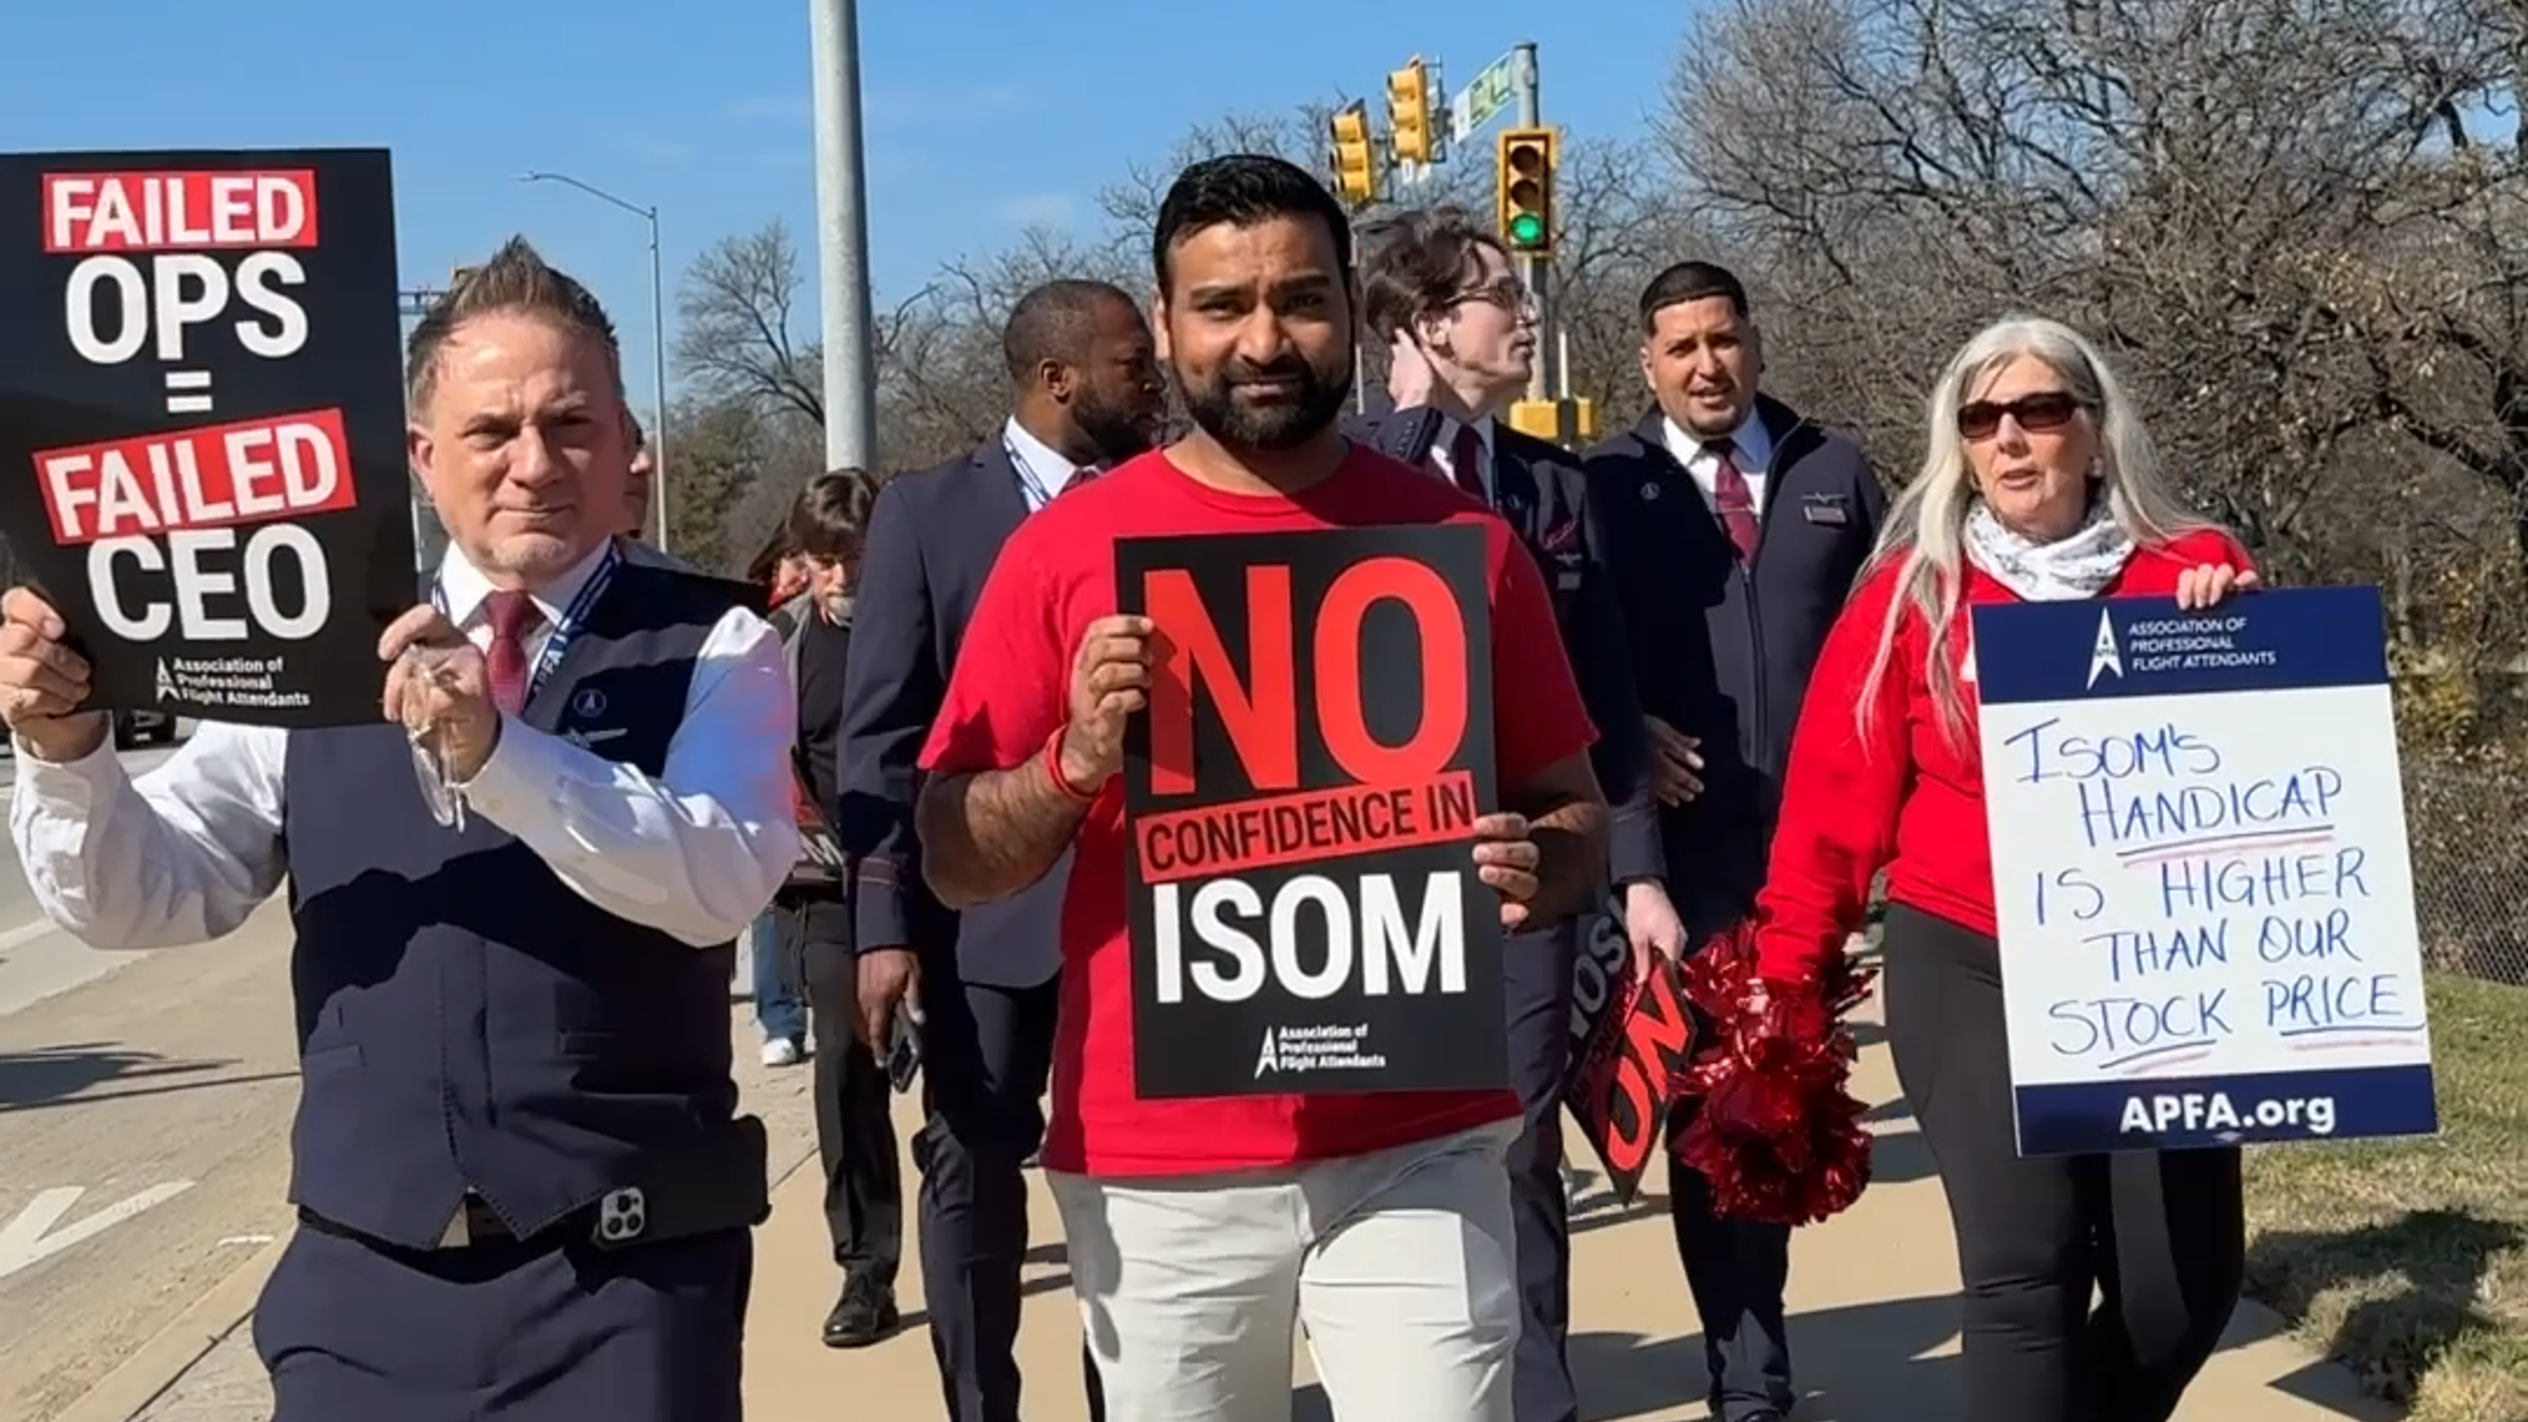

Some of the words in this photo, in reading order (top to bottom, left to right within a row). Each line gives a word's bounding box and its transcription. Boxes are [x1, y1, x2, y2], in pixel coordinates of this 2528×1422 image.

[52, 176, 304, 247] FAILED
[66, 252, 307, 363] OPS
[46, 423, 337, 537] FAILED
[87, 522, 330, 641] CEO
[2127, 618, 2223, 635] ASSOCIATION
[2225, 617, 2247, 632] OF
[2130, 636, 2235, 652] PROFESSIONAL
[2133, 655, 2181, 671] FLIGHT
[2182, 650, 2277, 669] ATTENDANTS
[173, 657, 264, 672] Association
[266, 656, 284, 672] of
[175, 673, 273, 690] Professional
[180, 688, 224, 705] Flight
[226, 690, 311, 706] Attendants
[1144, 556, 1468, 794] NO
[1146, 789, 1416, 873] CONFIDENCE
[1430, 781, 1473, 833] IN
[2078, 765, 2342, 847] HANDICAP
[2036, 868, 2105, 926] IS
[2160, 846, 2370, 918] HIGHER
[1153, 871, 1466, 1003] ISOM
[2082, 917, 2229, 982] THAN
[2257, 909, 2362, 964] OUR
[1278, 1025, 1352, 1039] Association
[1354, 1023, 1368, 1038] of
[1279, 1039, 1358, 1054] Professional
[2048, 988, 2233, 1056] STOCK
[2262, 973, 2404, 1027] PRICE
[1280, 1055, 1317, 1072] Flight
[1318, 1053, 1387, 1068] Attendants
[2120, 1093, 2336, 1139] APFA.org
